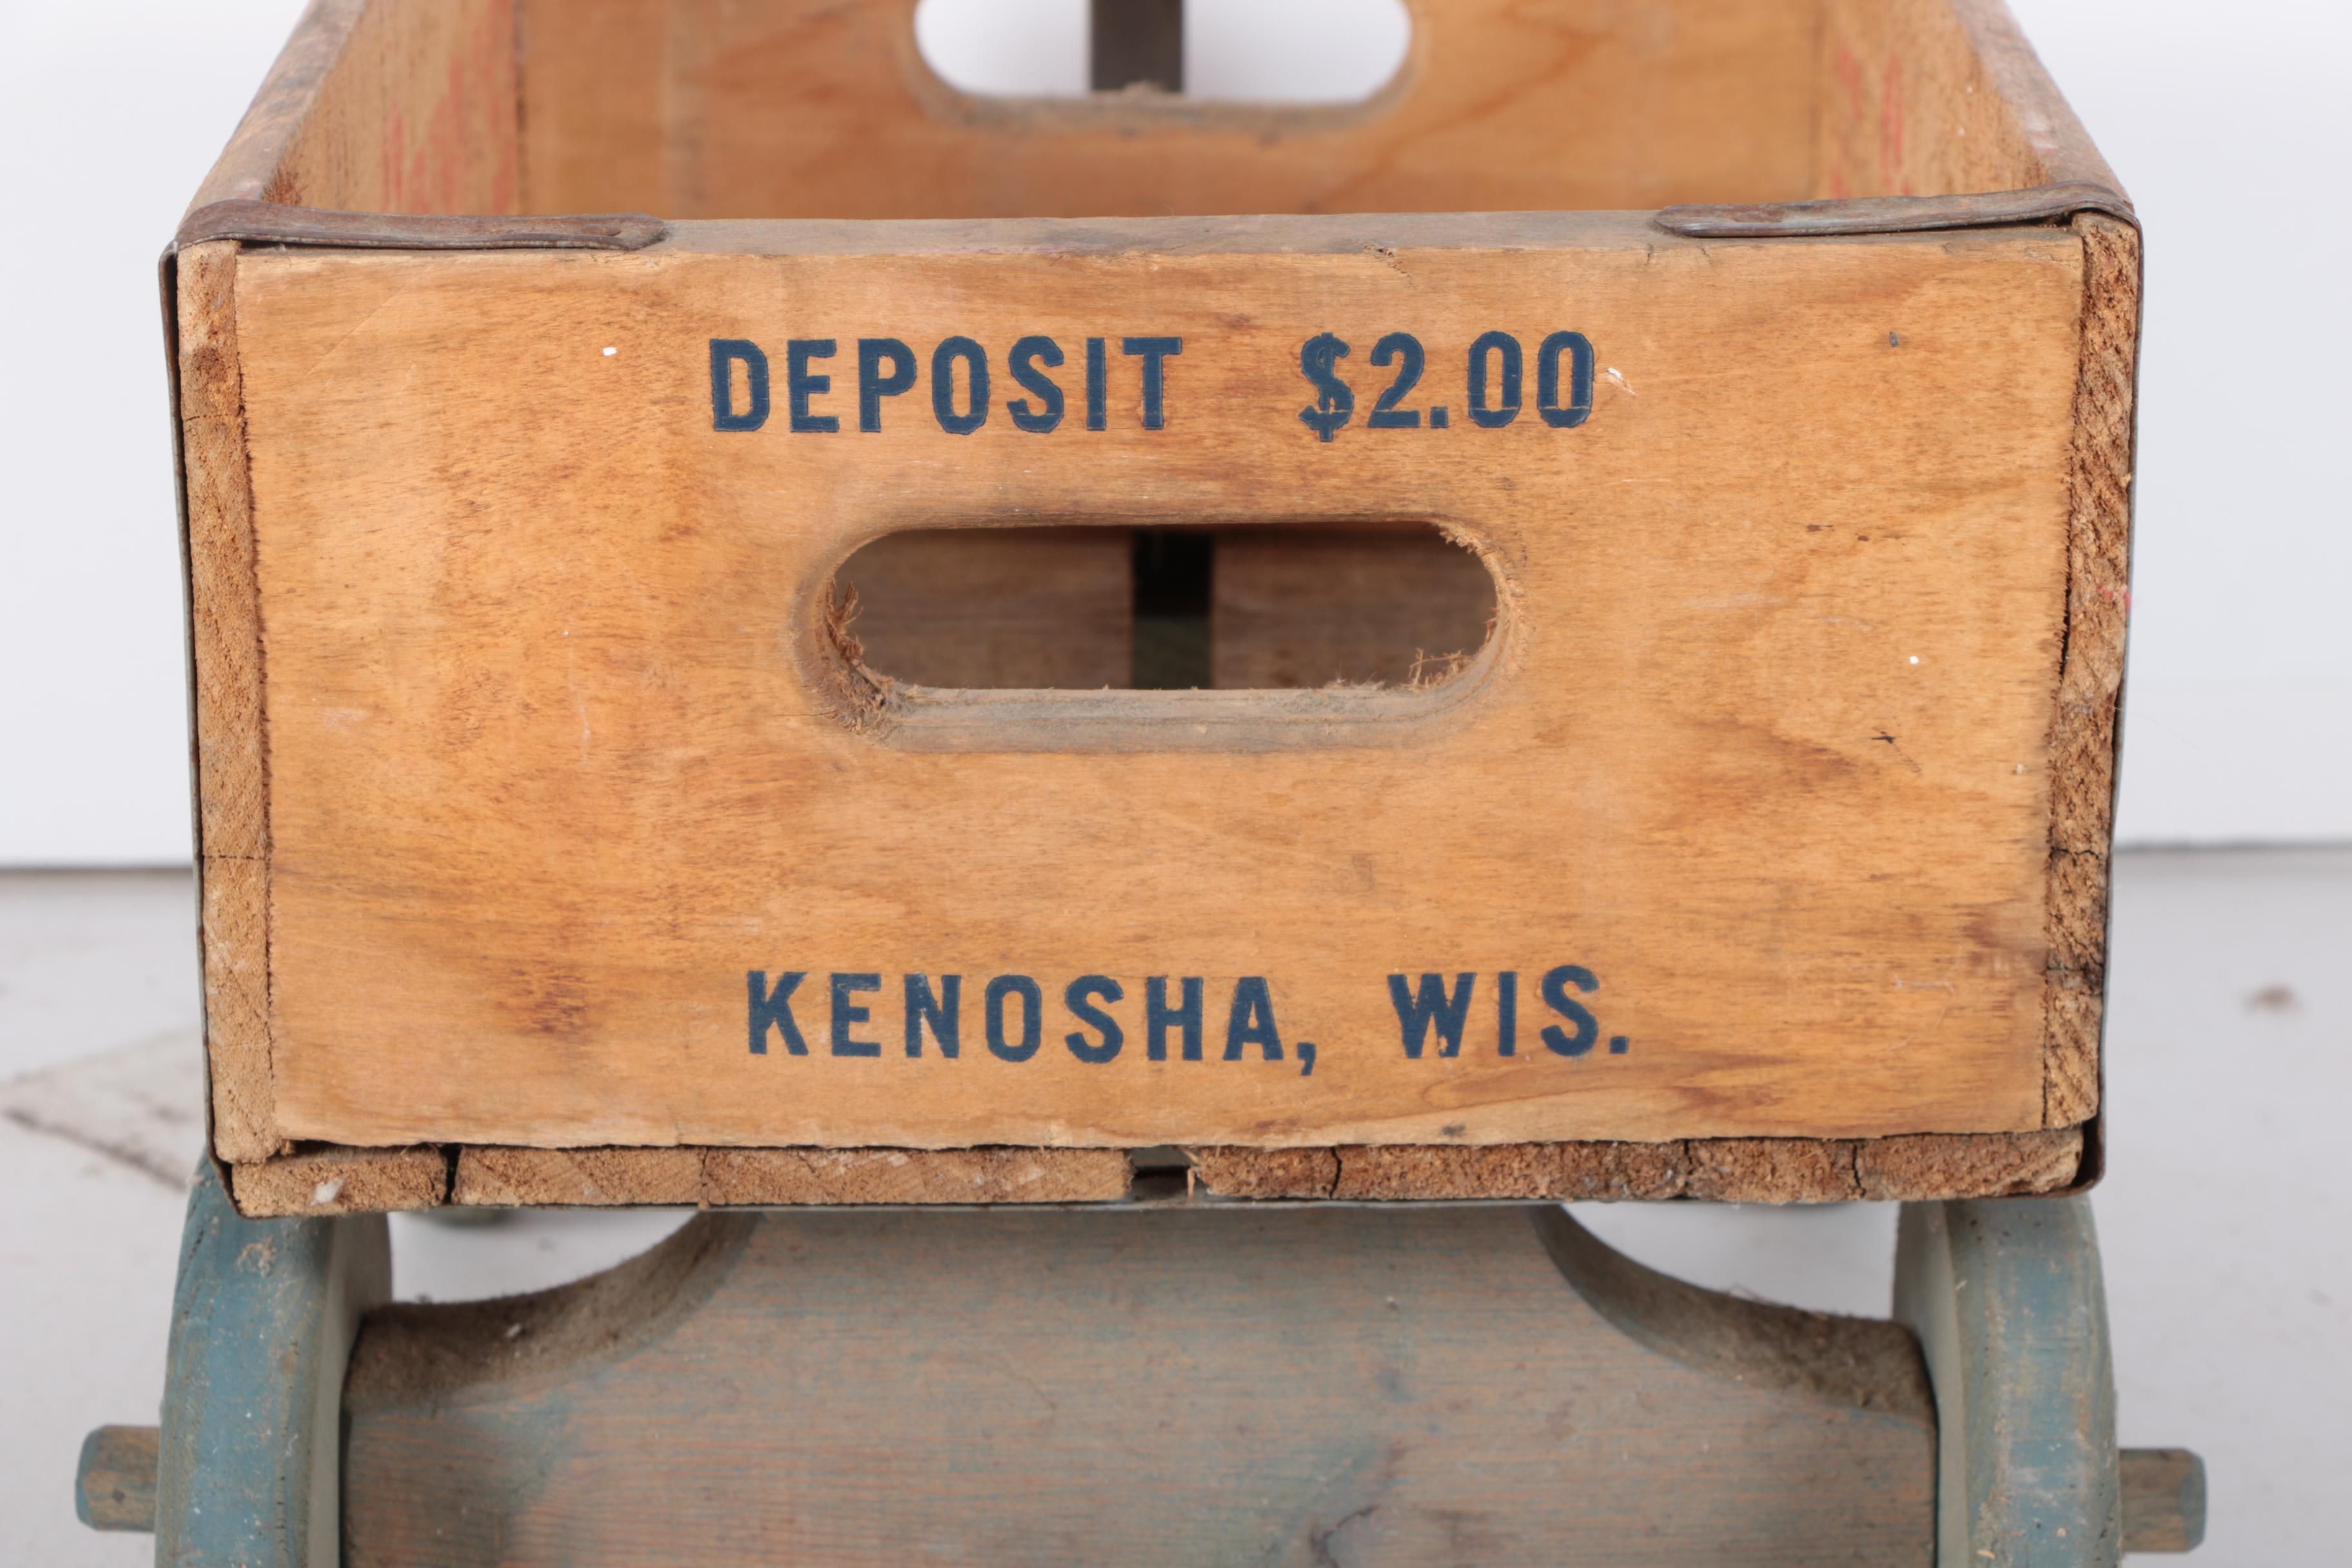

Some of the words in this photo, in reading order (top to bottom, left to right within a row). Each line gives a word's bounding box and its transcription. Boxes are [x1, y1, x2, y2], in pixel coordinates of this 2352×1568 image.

[711, 336, 1181, 434] DEPOSIT
[1300, 331, 1594, 439] $2.00
[749, 972, 1316, 1075] KENOSHA,
[1389, 965, 1628, 1059] WIS.
